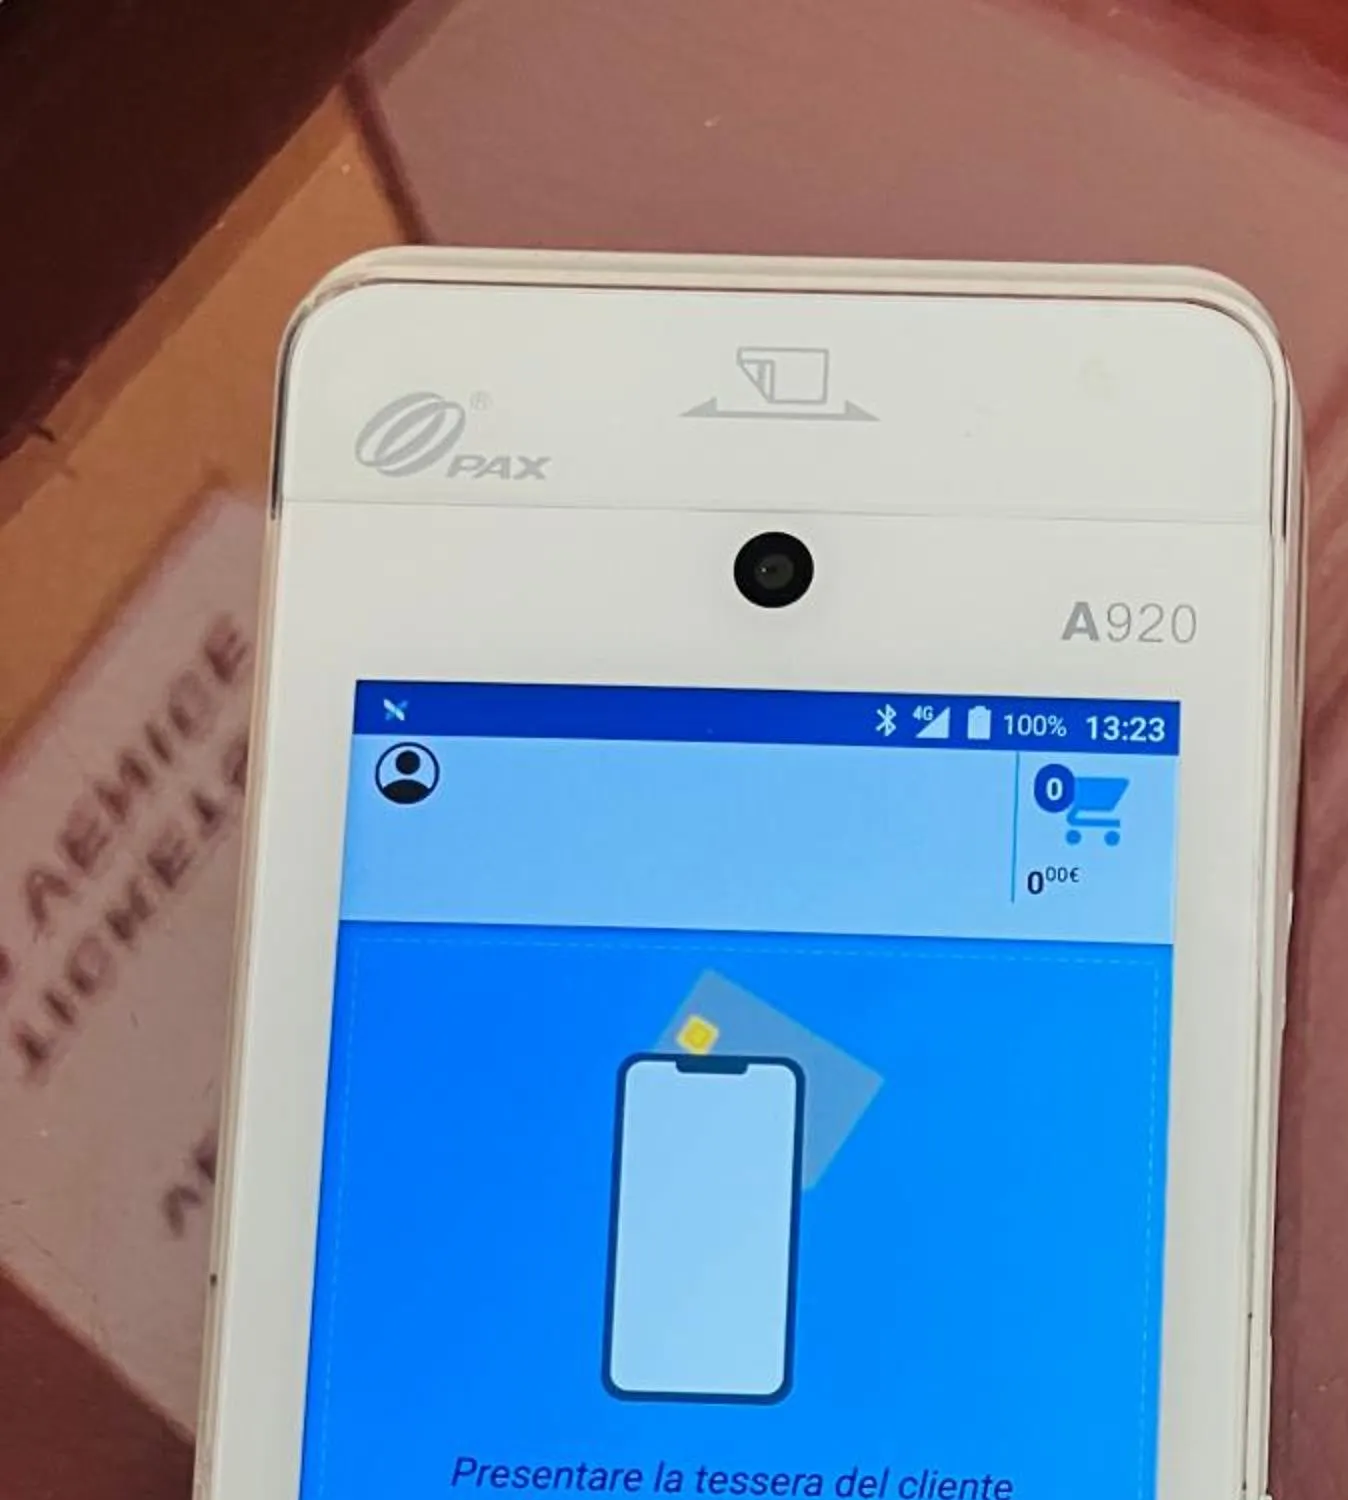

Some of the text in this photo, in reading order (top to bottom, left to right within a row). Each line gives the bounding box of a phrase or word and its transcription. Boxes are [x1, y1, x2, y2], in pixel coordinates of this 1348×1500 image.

[447, 455, 552, 479] PAX
[1061, 602, 1197, 643] A920
[912, 705, 1165, 742] 4G 100% 13:23
[1046, 777, 1063, 801] 0
[451, 1457, 643, 1493] Presentare
[653, 1461, 683, 1494] la
[697, 1466, 823, 1498] tessera
[834, 1467, 888, 1500] del
